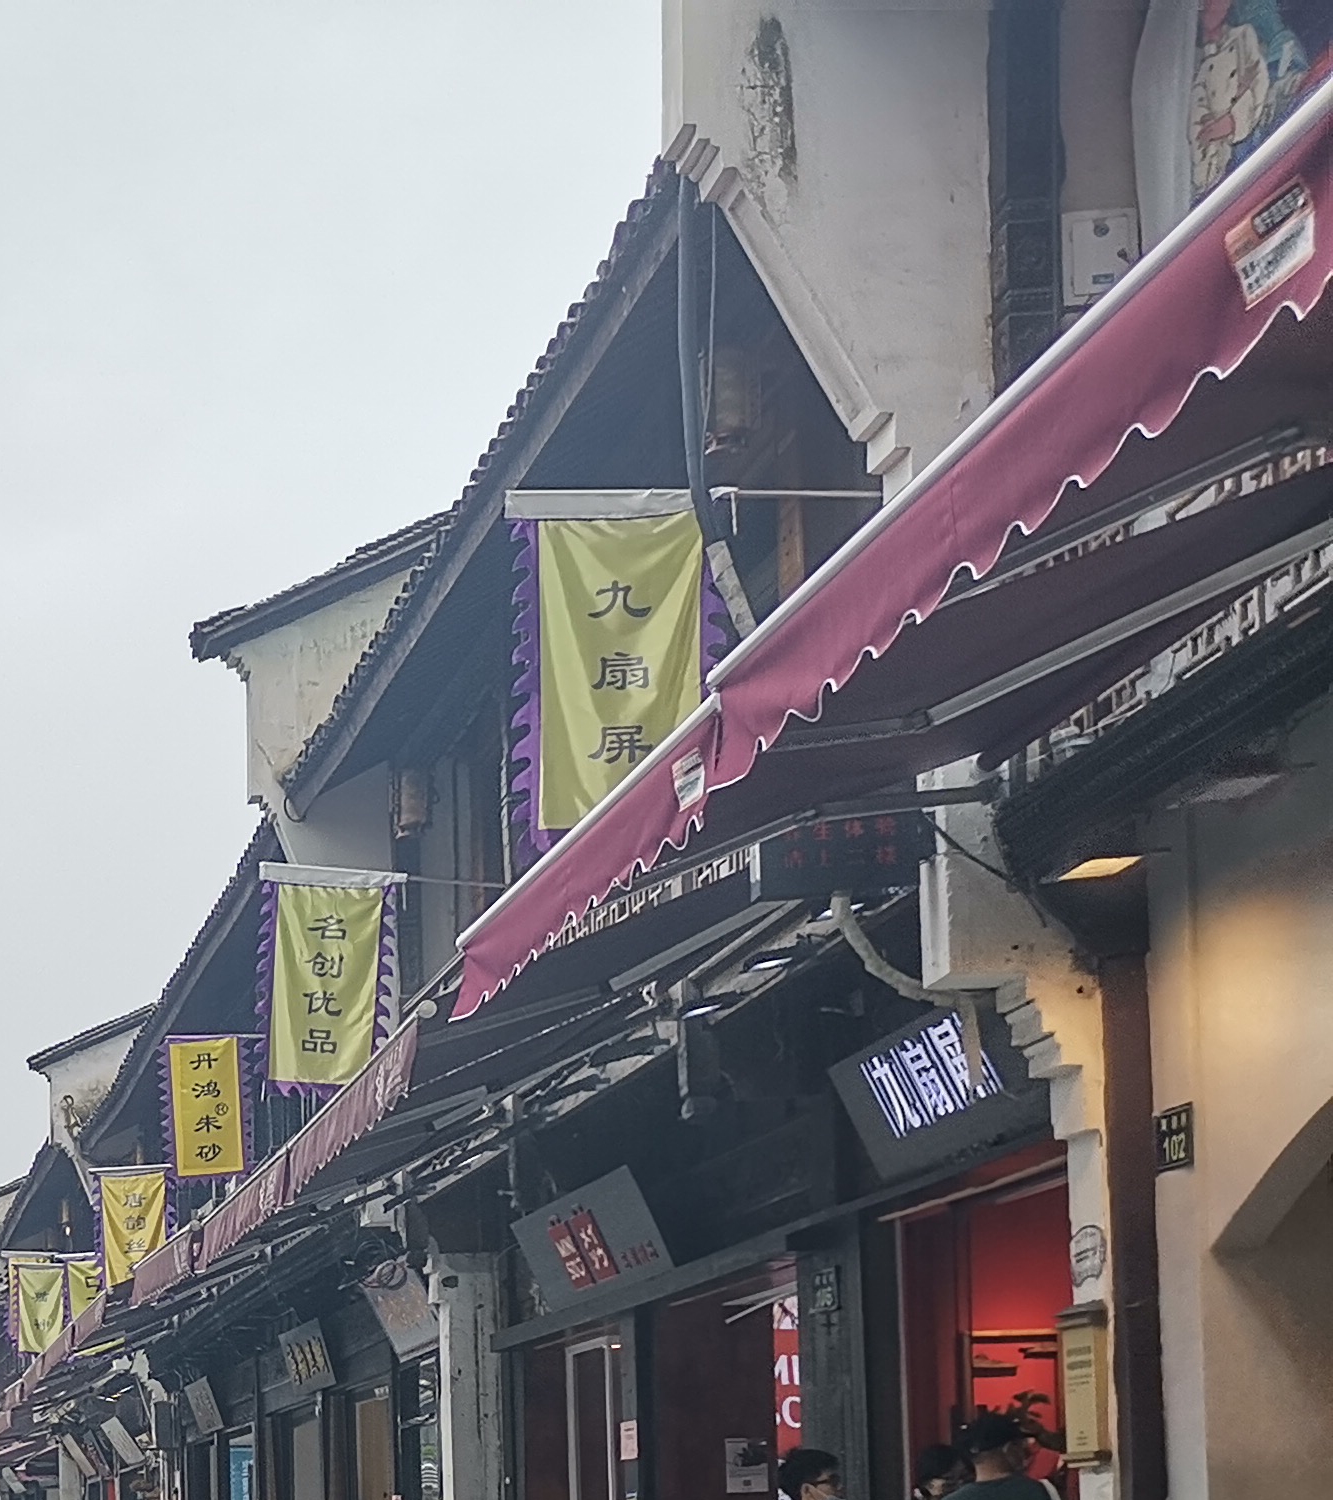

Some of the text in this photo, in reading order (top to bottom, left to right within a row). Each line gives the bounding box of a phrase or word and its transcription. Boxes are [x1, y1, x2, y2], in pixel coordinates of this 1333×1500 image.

[587, 578, 654, 766] 九扇屏
[300, 913, 348, 1055] 名创优品
[1162, 1132, 1186, 1163] 102
